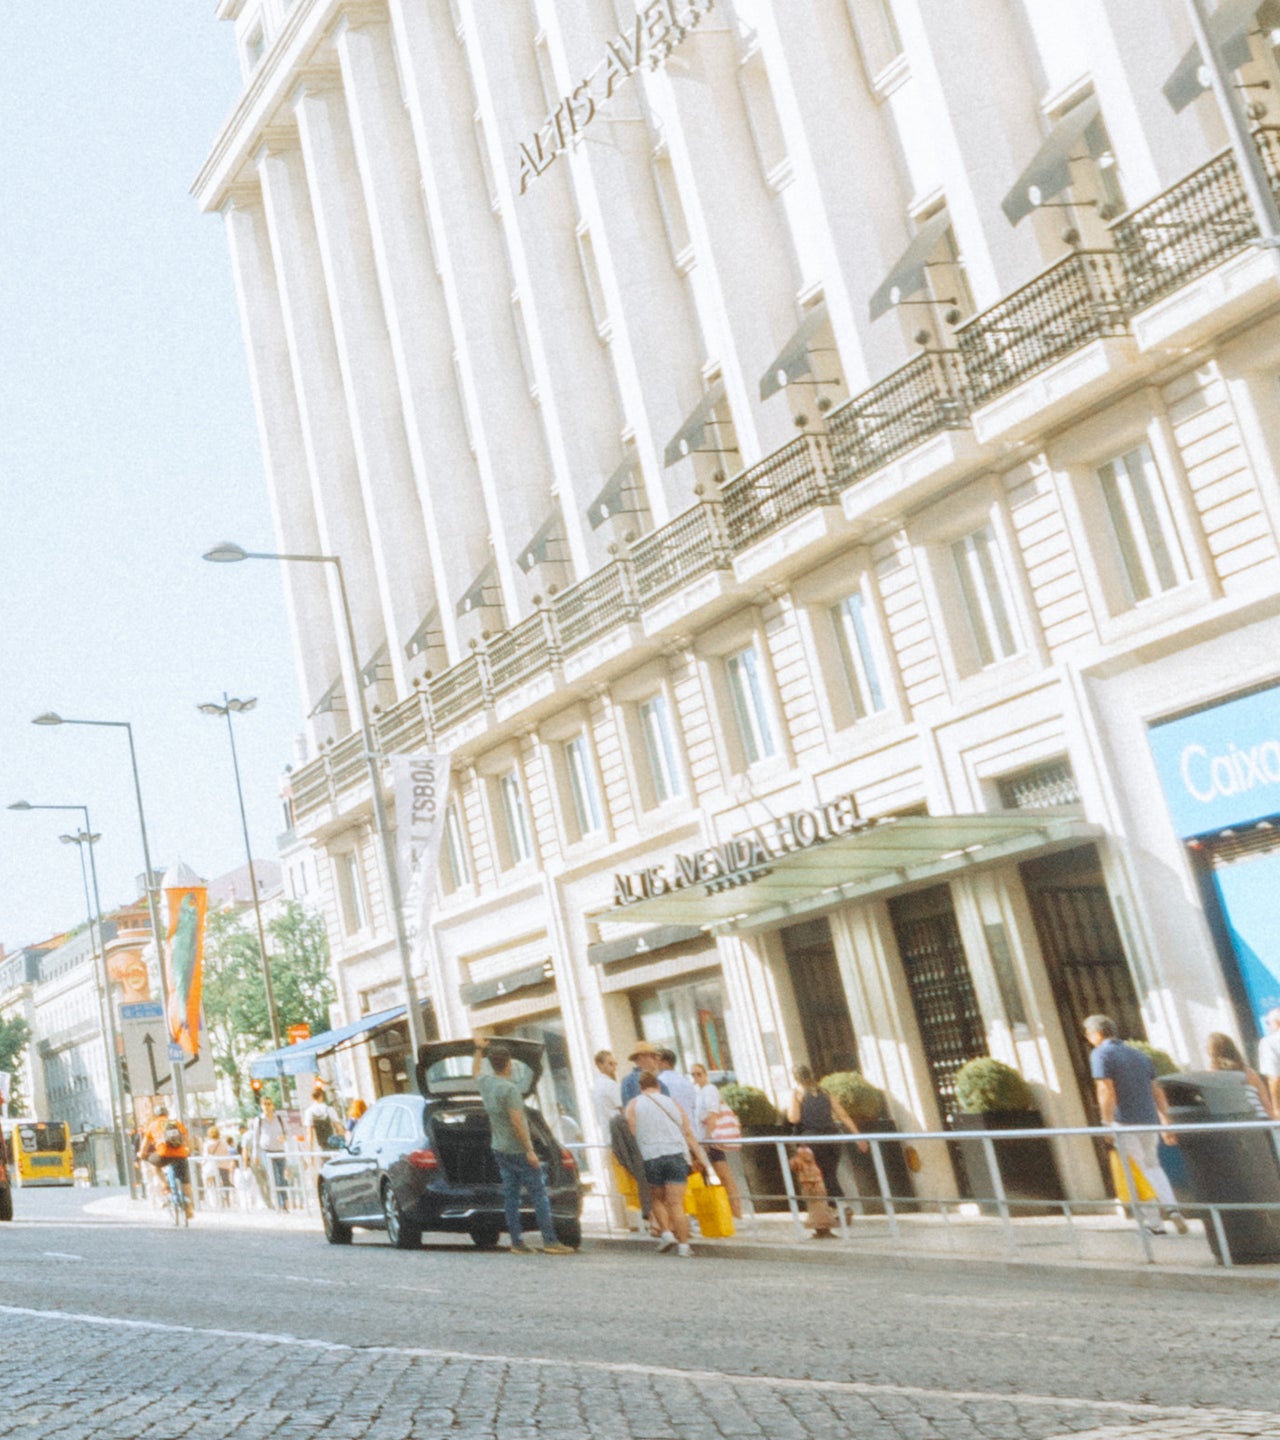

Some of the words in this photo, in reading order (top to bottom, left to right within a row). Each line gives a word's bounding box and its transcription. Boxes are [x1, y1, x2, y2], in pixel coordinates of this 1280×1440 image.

[519, 77, 596, 197] ALTIS
[613, 863, 673, 907] ALTIS
[673, 827, 774, 889] AVENIDA
[775, 791, 869, 855] HOTEL
